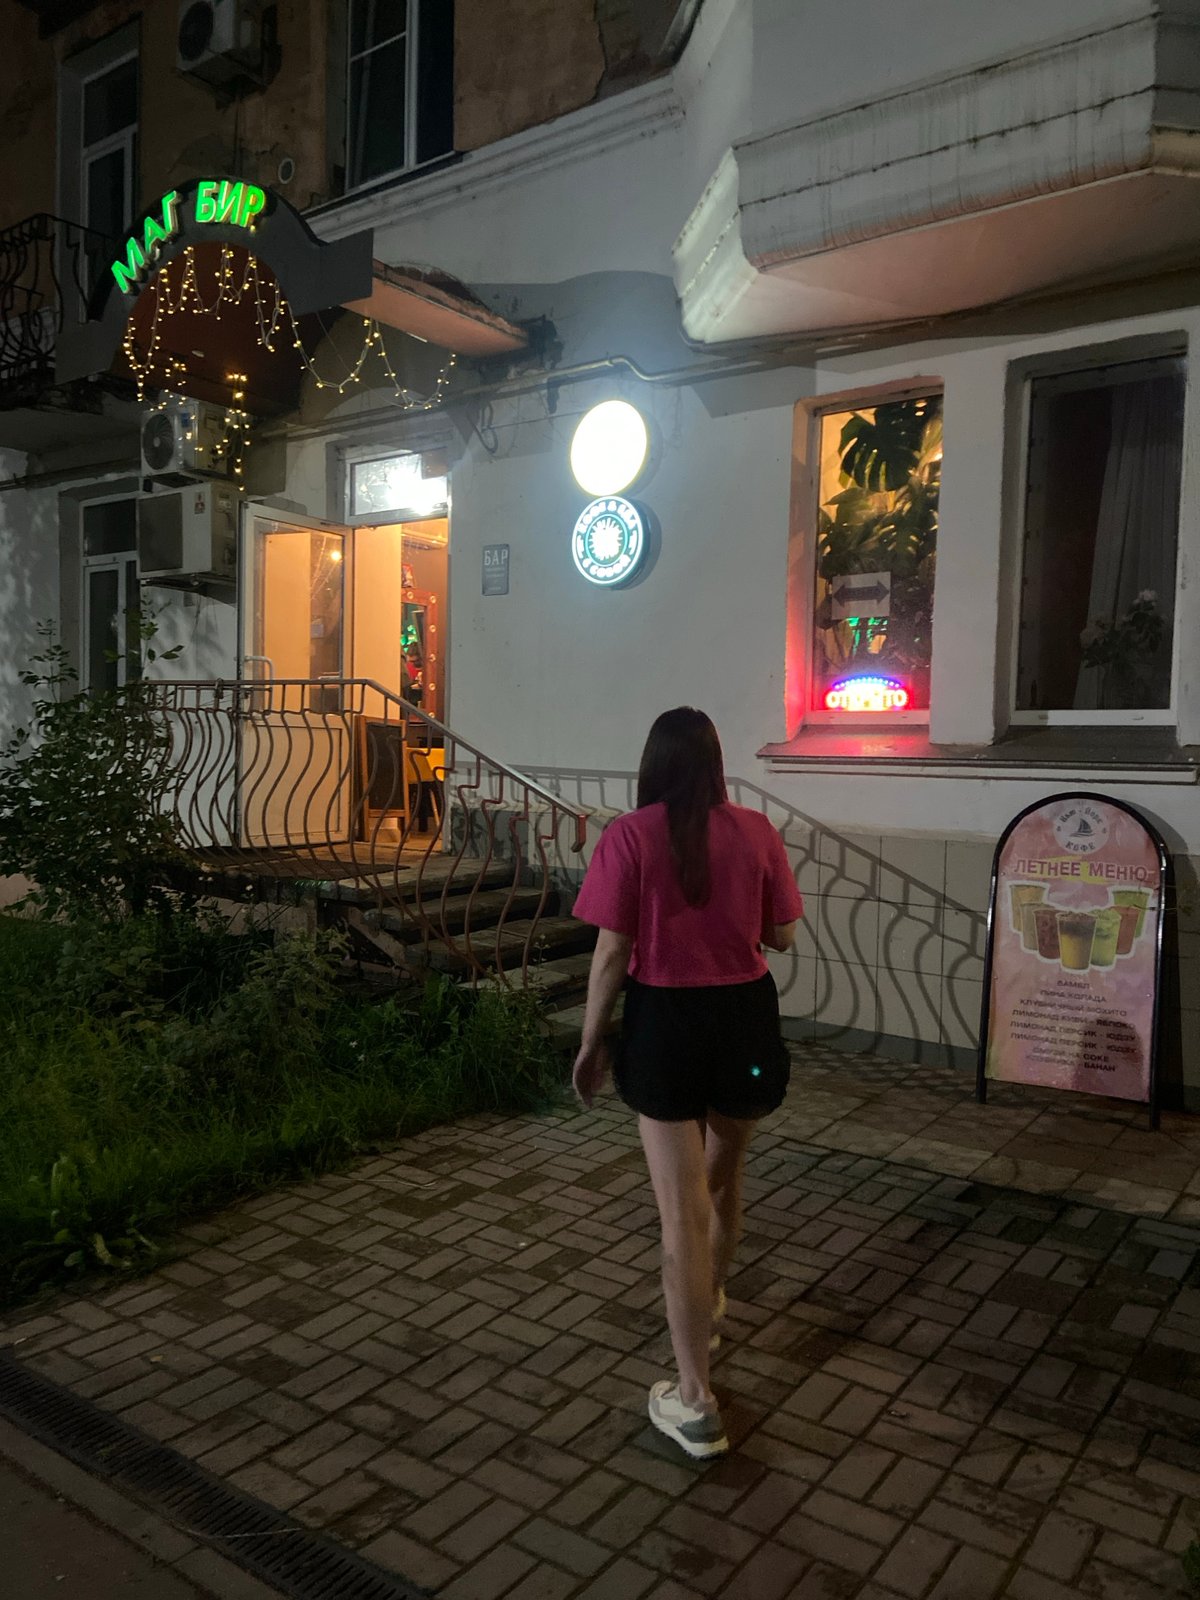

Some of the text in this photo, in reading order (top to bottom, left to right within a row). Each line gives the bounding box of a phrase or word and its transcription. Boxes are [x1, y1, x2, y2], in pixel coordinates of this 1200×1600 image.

[111, 180, 266, 294] МАГ БИР
[484, 549, 508, 566] БАР
[1065, 840, 1096, 852] КОФЕ
[1014, 859, 1149, 881] ЛЕТНЕЕ МЕНЮ
[1067, 993, 1107, 1003] КОЛАДА
[1012, 1009, 1059, 1021] ЛИМОНАД
[1096, 1018, 1136, 1030] ЯБЛОКО
[1010, 1020, 1057, 1033] ЛИМОНАД
[1010, 1032, 1057, 1045] ЛИМОНАД
[1083, 1053, 1109, 1063] СОКЕ
[1084, 1061, 1116, 1072] БАНАН
